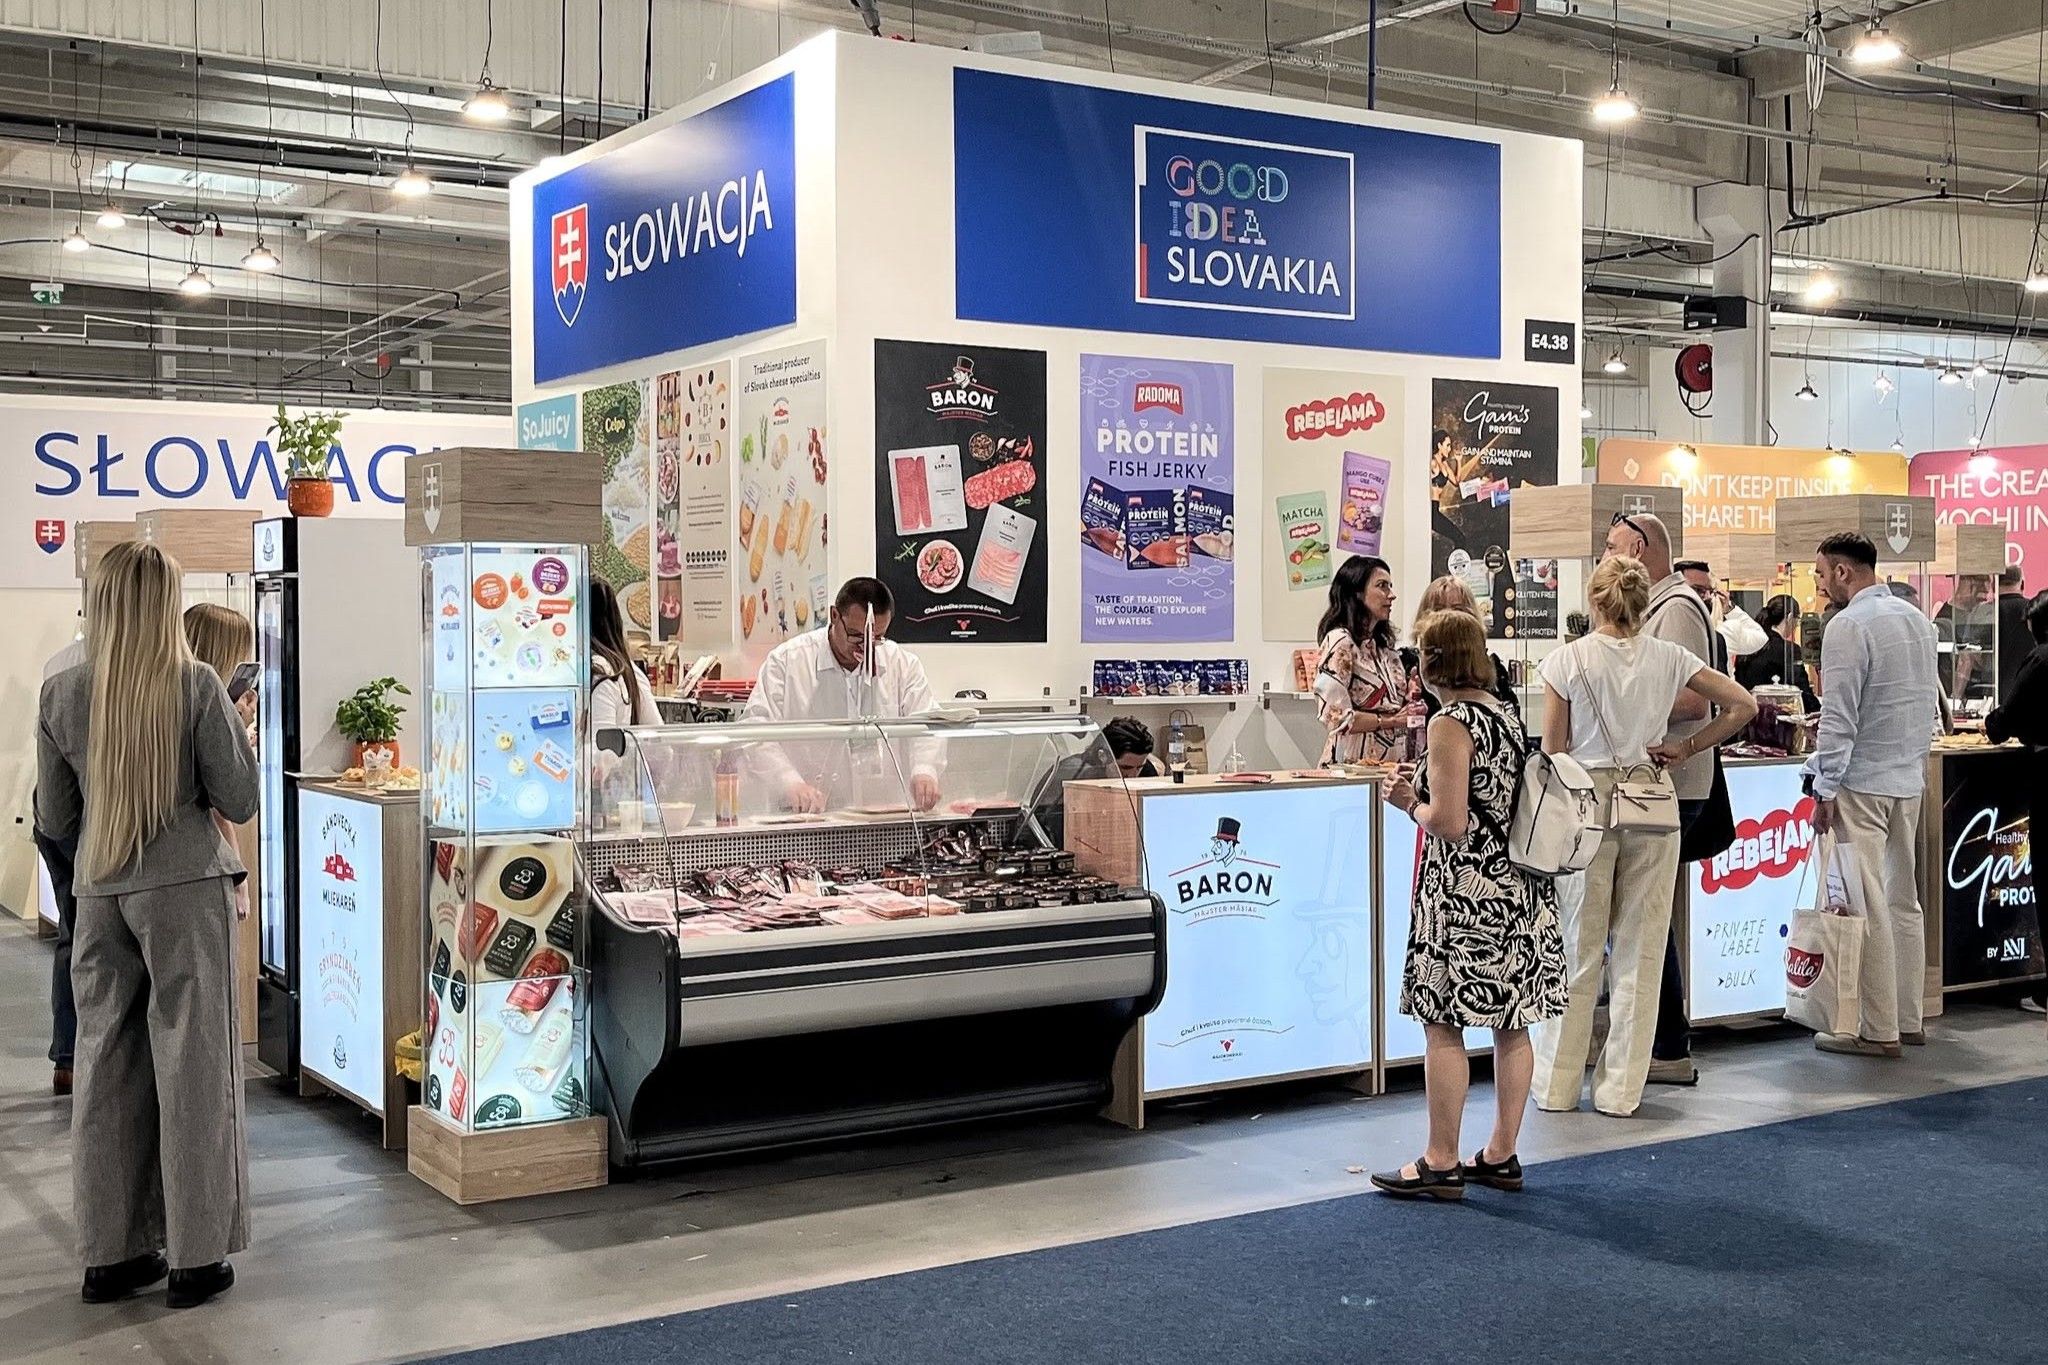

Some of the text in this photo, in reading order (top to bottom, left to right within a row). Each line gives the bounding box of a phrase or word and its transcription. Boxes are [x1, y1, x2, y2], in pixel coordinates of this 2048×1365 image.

[1165, 155, 1289, 202] GOOD
[604, 169, 773, 282] SŁOWACJA
[1167, 200, 1267, 246] IDEA
[1166, 245, 1341, 297] SLOVAKIA
[1531, 333, 1569, 351] E4.38
[931, 389, 994, 410] BARON
[1137, 387, 1180, 405] RADOMA
[1293, 399, 1377, 433] REBELAMA
[1488, 424, 1521, 435] PROTEIN
[1097, 428, 1218, 458] PROTEIN
[35, 432, 442, 503] SŁOWAC
[1109, 460, 1207, 479] FISH JERKY
[1662, 472, 1724, 498] DON'T
[1727, 474, 1773, 499] KEEP
[1776, 477, 1791, 499] IT
[1924, 472, 1975, 499] THE
[1128, 508, 1169, 520] PROTEIN
[1282, 507, 1324, 523] MATCHA
[1682, 504, 1744, 528] SHARE
[1172, 488, 1188, 568] SALMON
[1095, 595, 1121, 604] TASTE
[1123, 595, 1136, 604] OF
[1095, 605, 1207, 615] THE COURAGE TO EXPLORE
[1095, 617, 1116, 626] NEW
[1711, 819, 1815, 881] REBELAM
[1177, 871, 1272, 904] BARON
[1714, 918, 1767, 940] PRIVATE
[1720, 937, 1760, 957] LABEL
[1987, 947, 1998, 958] BY
[1724, 968, 1756, 989] BULK
